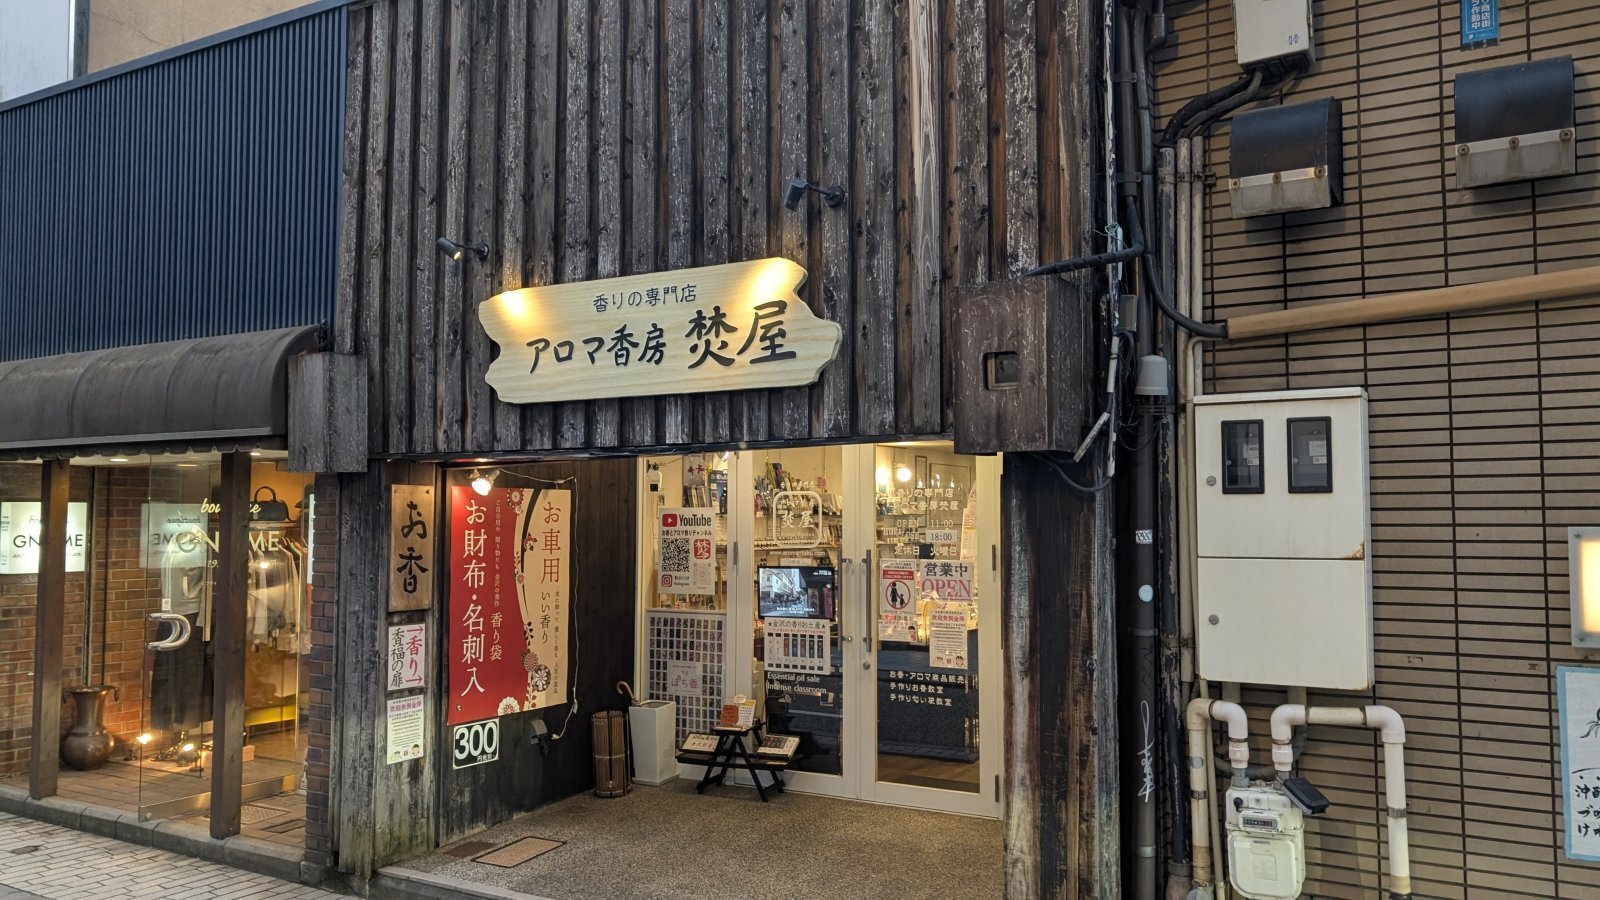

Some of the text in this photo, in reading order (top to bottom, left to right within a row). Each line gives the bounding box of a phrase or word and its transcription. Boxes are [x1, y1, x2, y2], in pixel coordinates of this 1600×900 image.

[593, 283, 697, 313] 香りの専門店
[526, 299, 797, 374] アロマ香房 焚屋
[679, 514, 711, 526] YouTube
[782, 510, 814, 528] 焚屋
[930, 520, 954, 528] 11:00
[13, 533, 83, 549] GNME
[541, 502, 561, 584] お車用
[931, 533, 953, 541] 18:00
[397, 500, 429, 593] お香
[894, 545, 957, 556] 定休日 火曜日
[924, 562, 968, 578] 営業中
[921, 578, 972, 599] OPEN
[461, 499, 488, 697] お財布・名刺入
[540, 591, 551, 644] いい香り
[489, 612, 503, 660] 香り袋
[405, 635, 423, 677] 香り
[767, 672, 820, 684] Essential oil sale
[889, 670, 965, 685] お香・アロマ商品販売
[767, 681, 827, 694] Incense classroom
[889, 682, 944, 695] 手作りお香教室
[454, 722, 497, 760] 300
